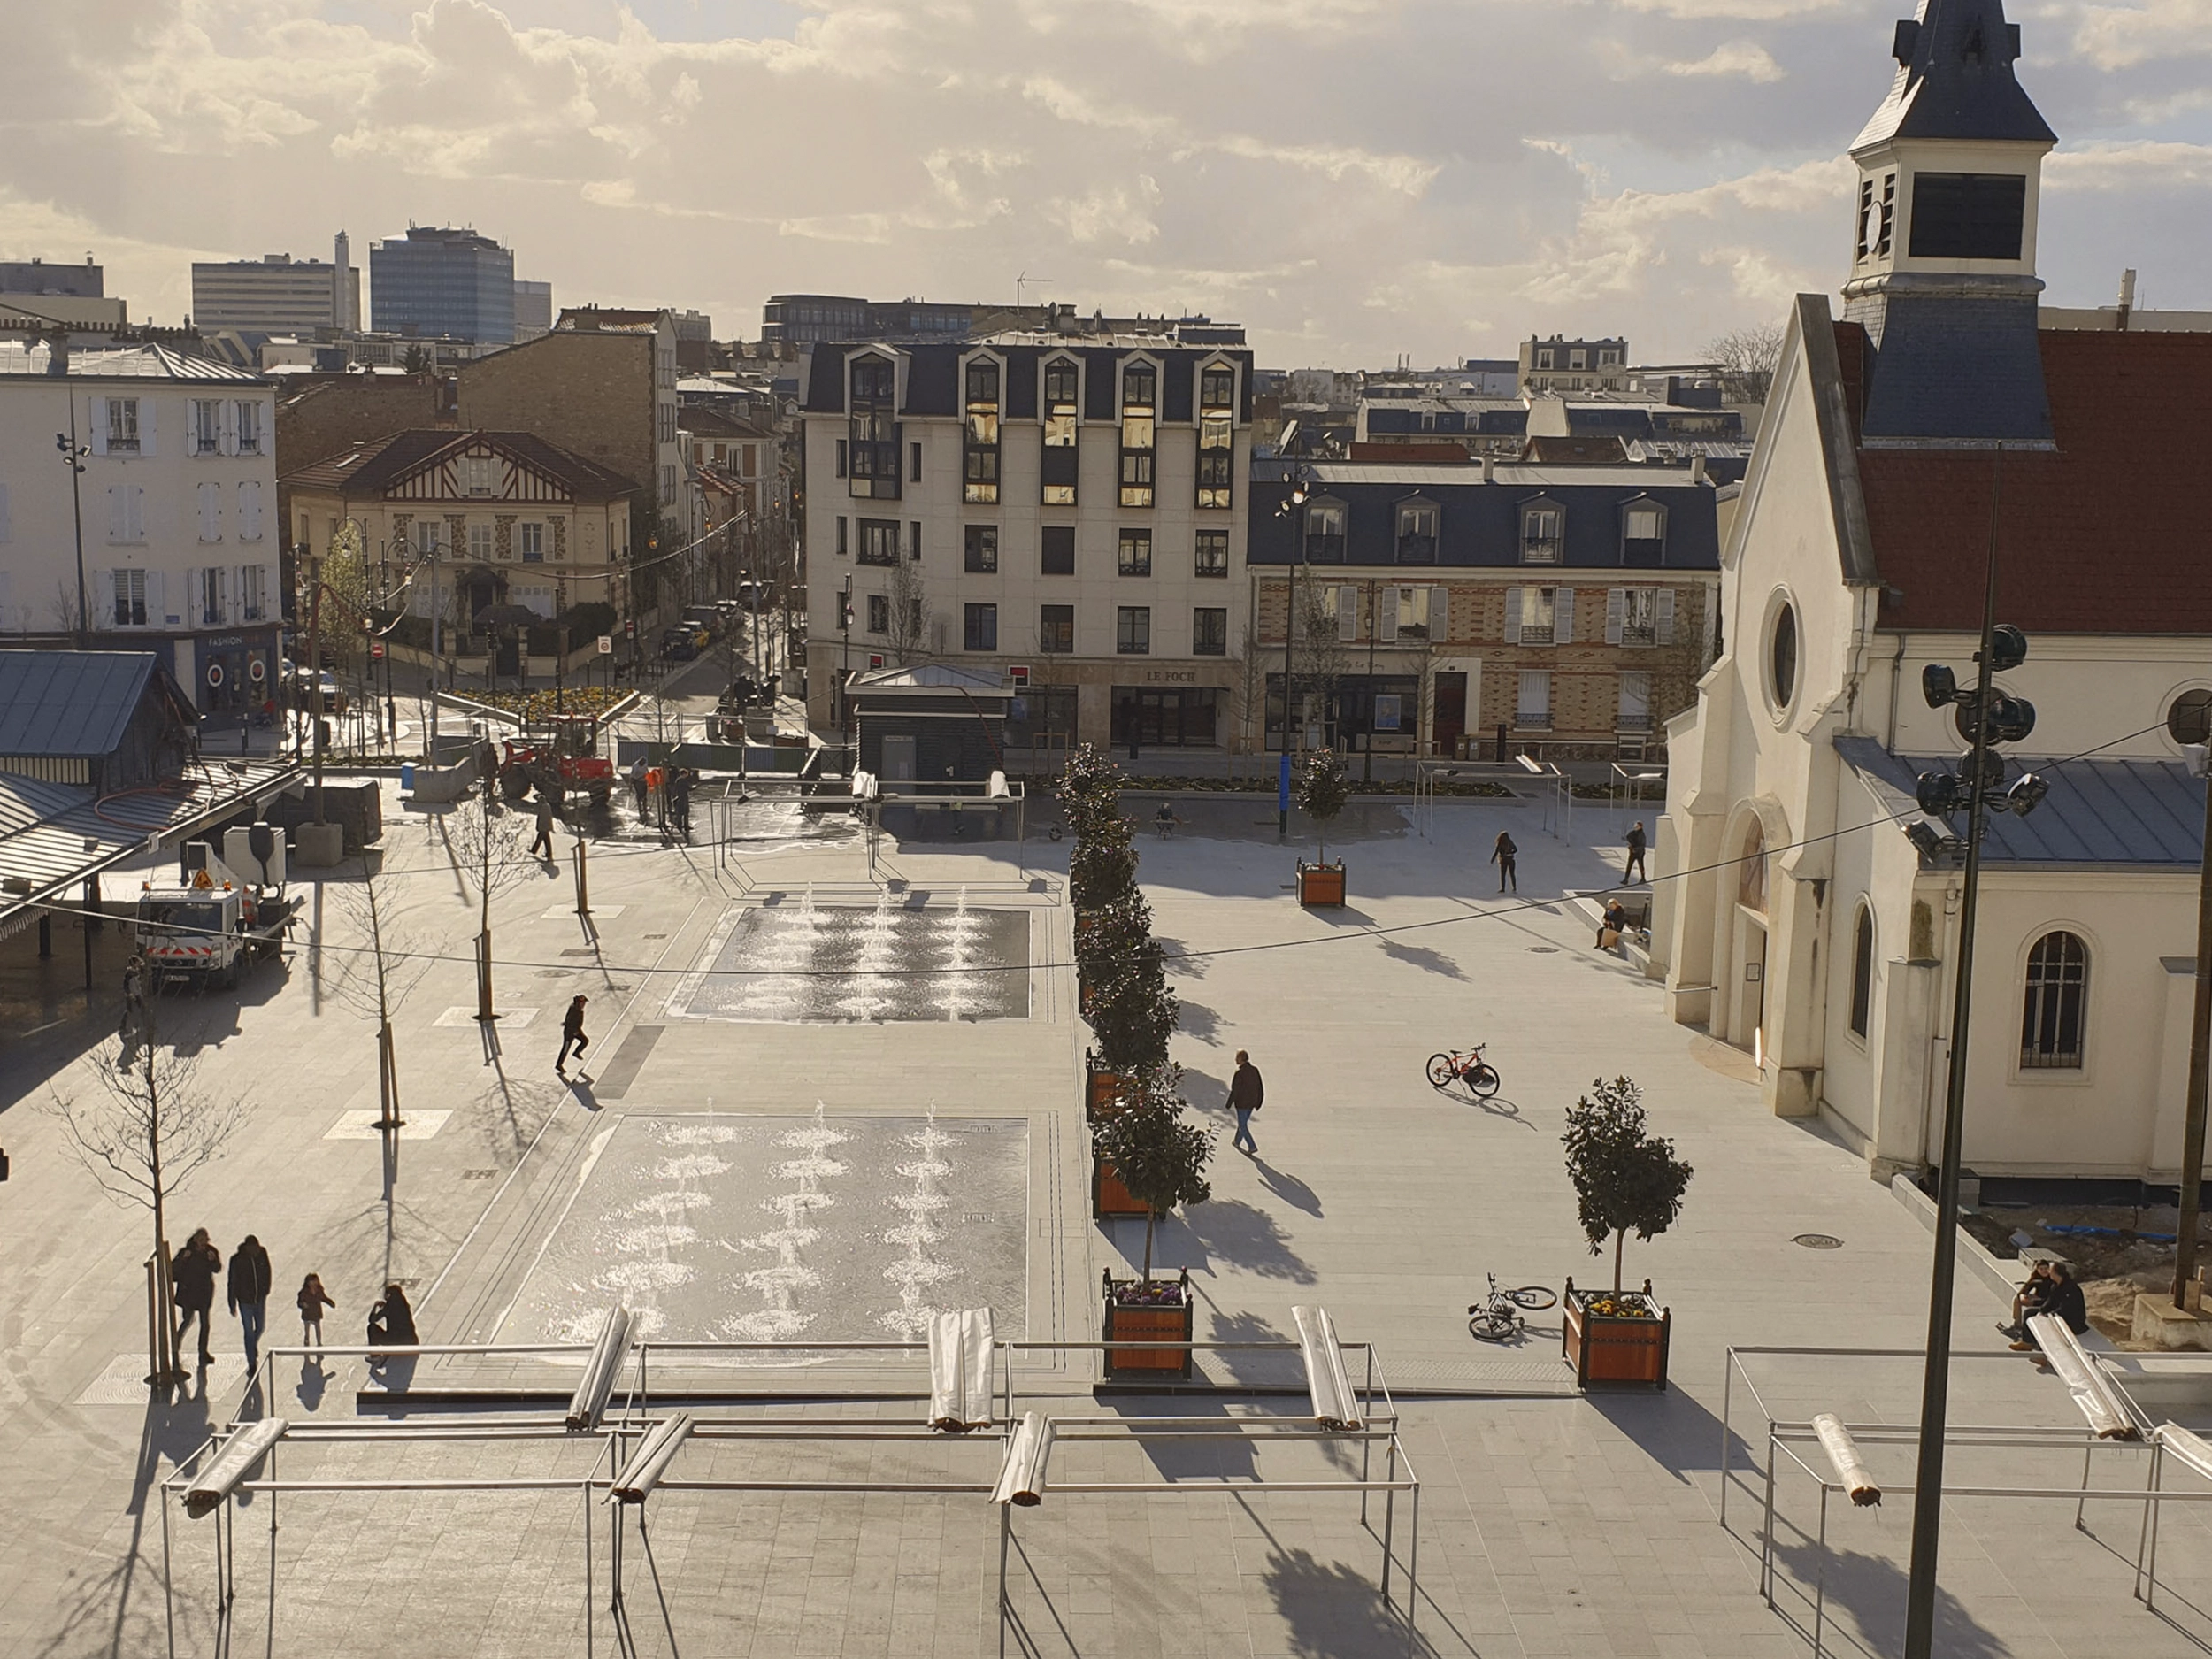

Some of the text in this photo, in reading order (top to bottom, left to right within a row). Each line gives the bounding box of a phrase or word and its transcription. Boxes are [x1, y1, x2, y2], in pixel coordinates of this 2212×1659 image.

[209, 636, 242, 647] FASHION
[1147, 672, 1196, 682] LE FOCH
